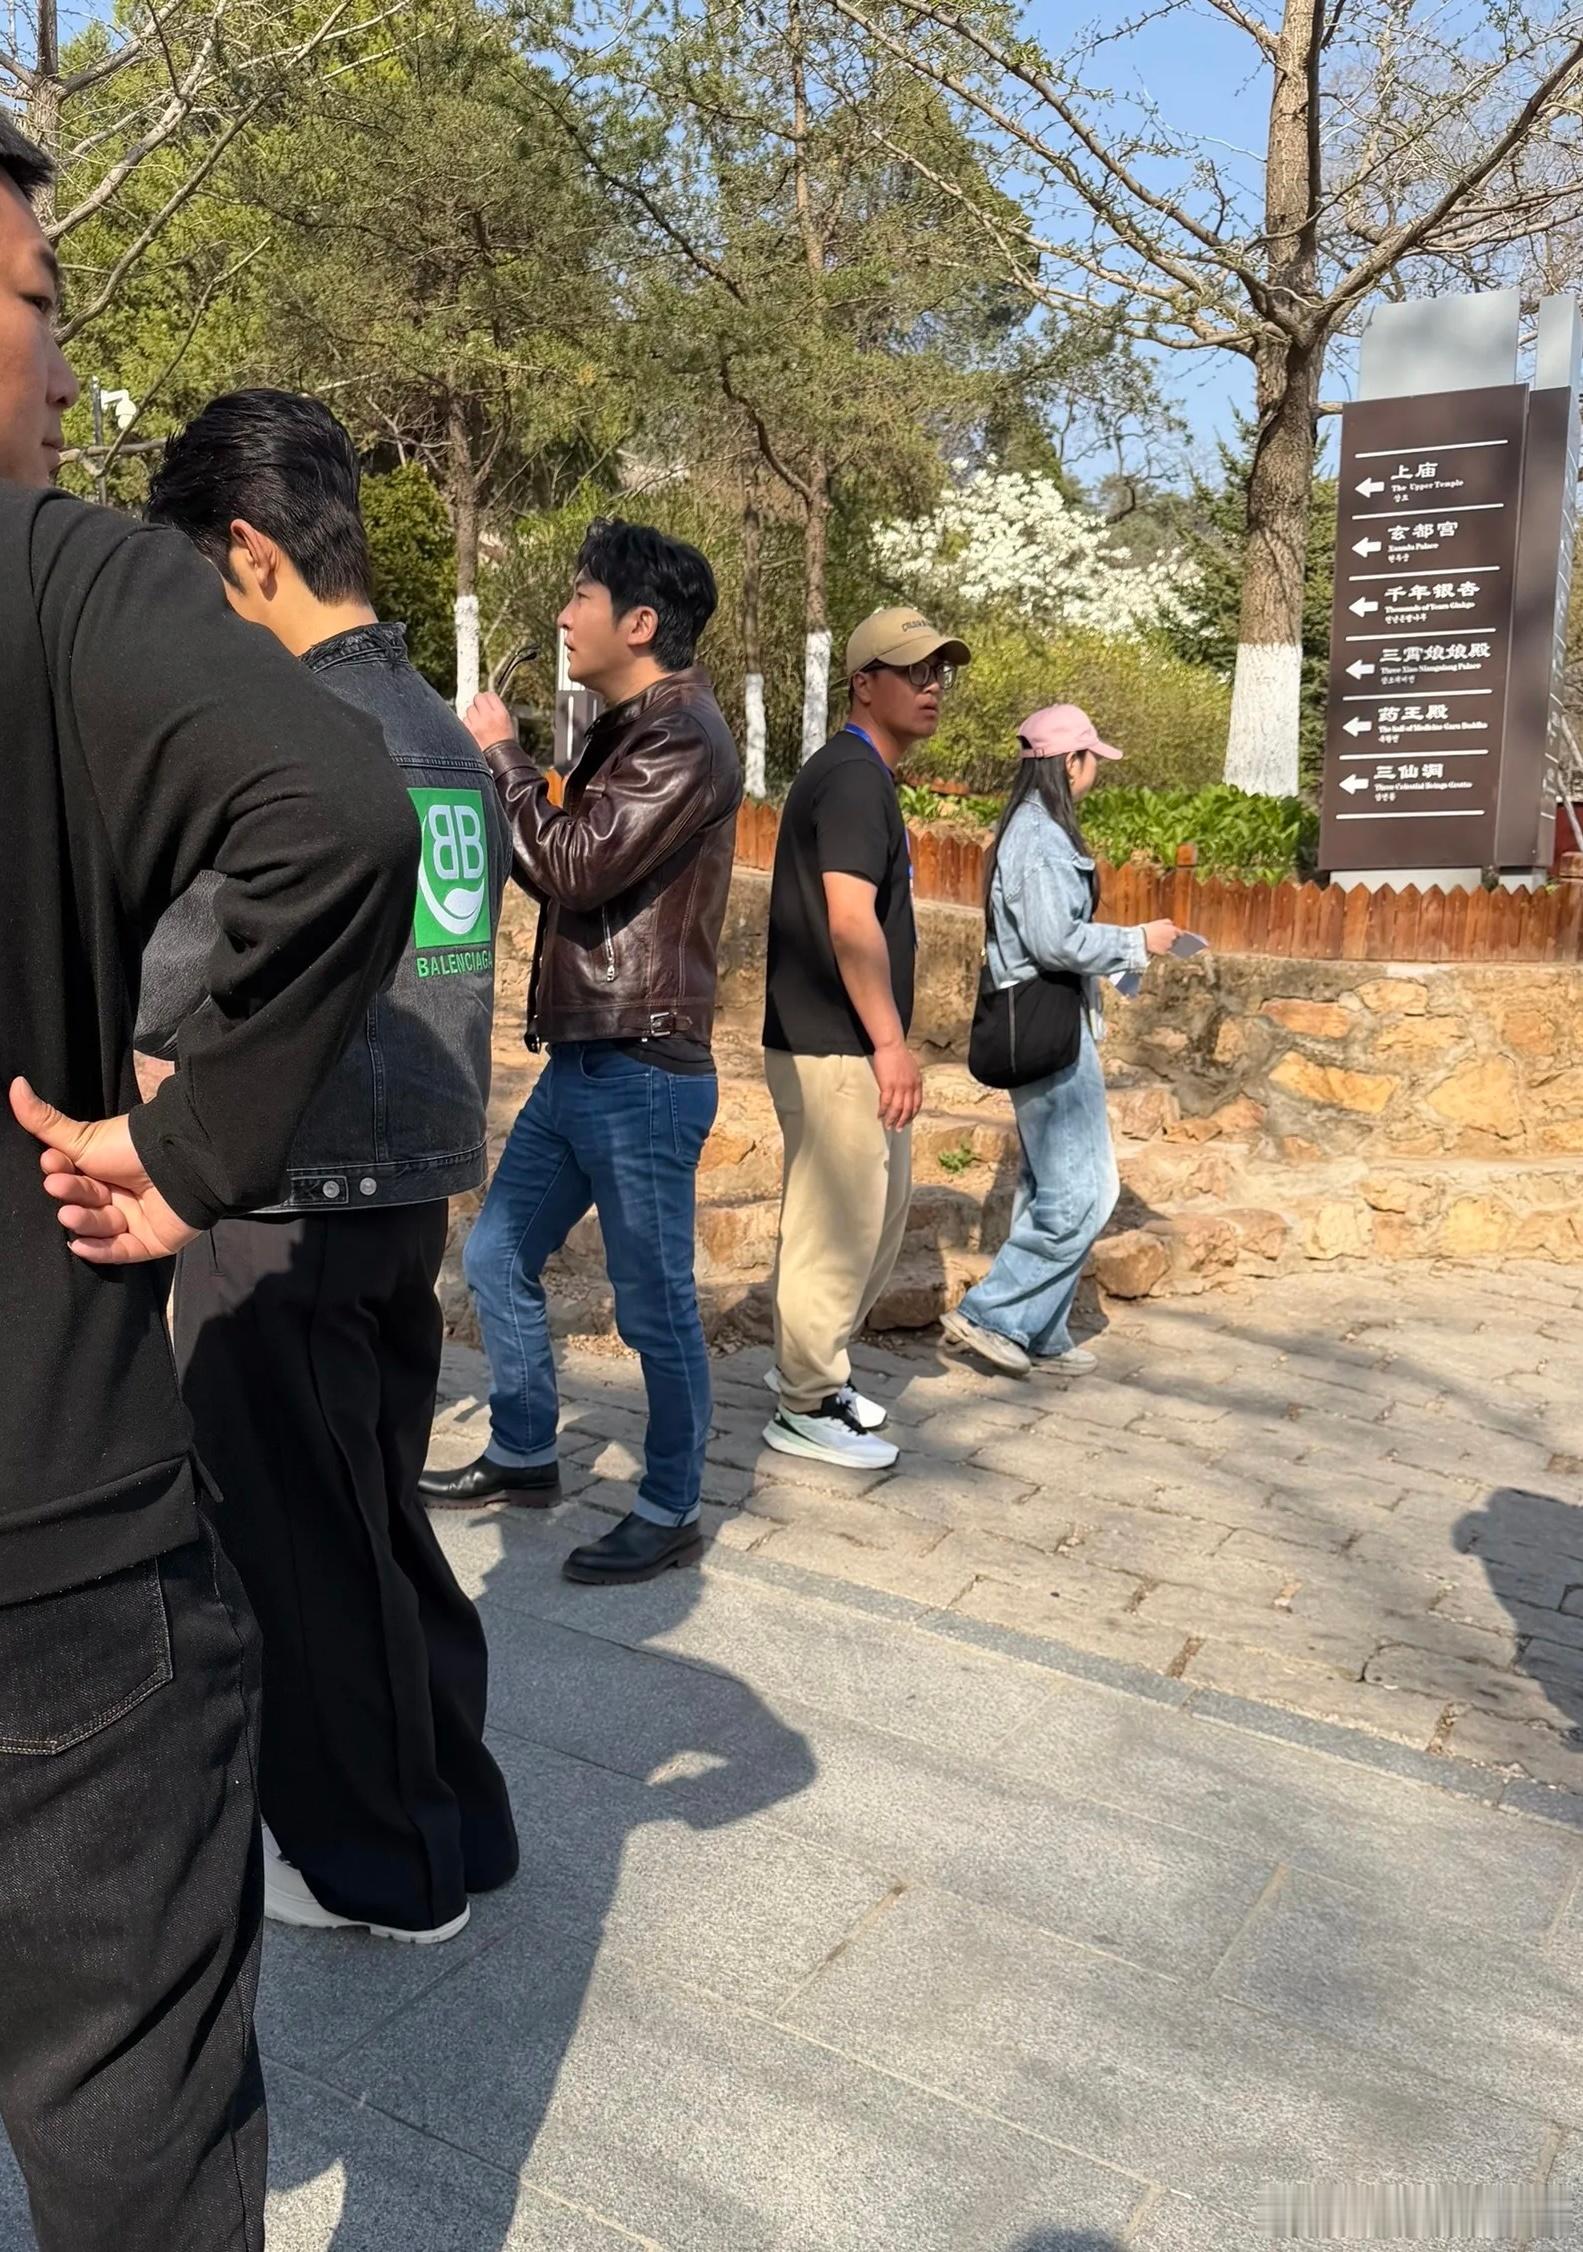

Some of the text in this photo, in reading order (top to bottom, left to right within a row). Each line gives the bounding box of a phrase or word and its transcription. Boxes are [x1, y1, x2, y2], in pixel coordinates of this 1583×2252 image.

[1390, 462, 1438, 480] 上庙
[1391, 479, 1464, 492] The Upper Temple
[1387, 521, 1458, 541] 玄都宫
[1384, 581, 1480, 602] 千年银杏
[1379, 642, 1491, 662] 三霄娘娘殿
[1377, 704, 1448, 722] 药王殿
[1373, 763, 1443, 780] 三仙洞
[416, 950, 493, 978] BALENCIAGA
